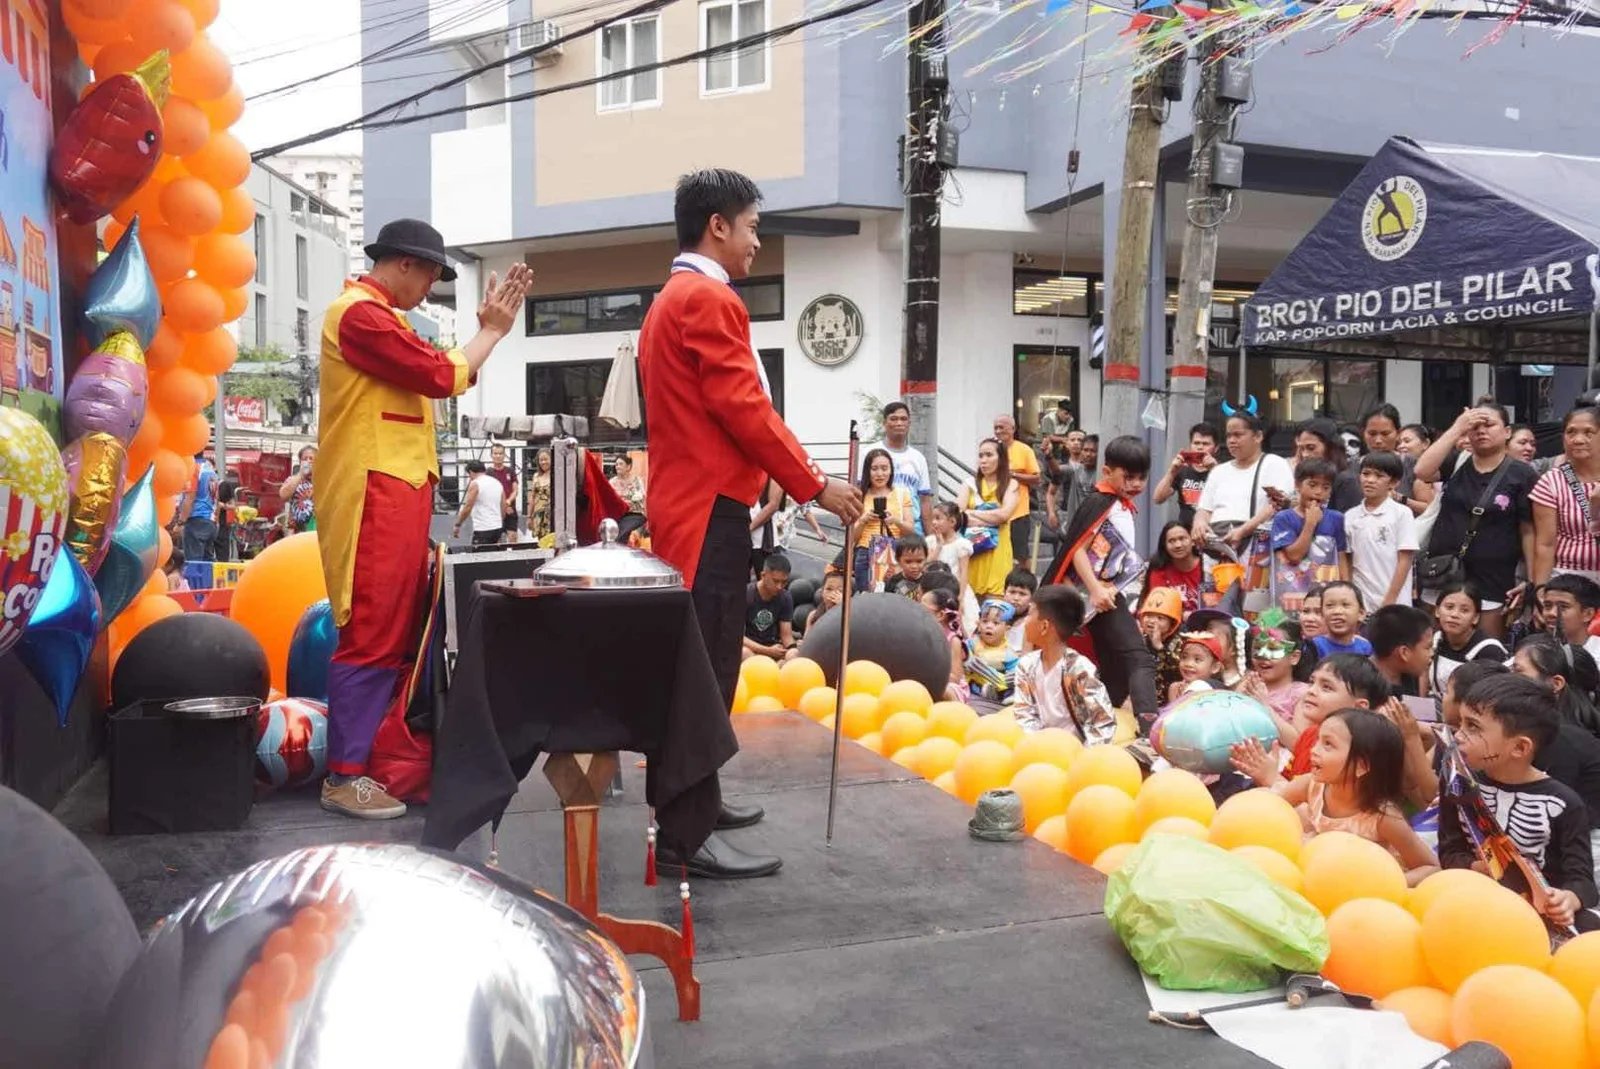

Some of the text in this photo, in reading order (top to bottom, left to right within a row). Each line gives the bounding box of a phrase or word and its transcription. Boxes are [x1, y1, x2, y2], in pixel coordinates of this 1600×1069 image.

[1404, 181, 1419, 198] DEL
[1257, 261, 1574, 328] BRGY. PIO DEL PILAR
[1254, 297, 1573, 344] KAP. POPCORN LACIA & COUNCIL
[814, 347, 845, 359] DINER
